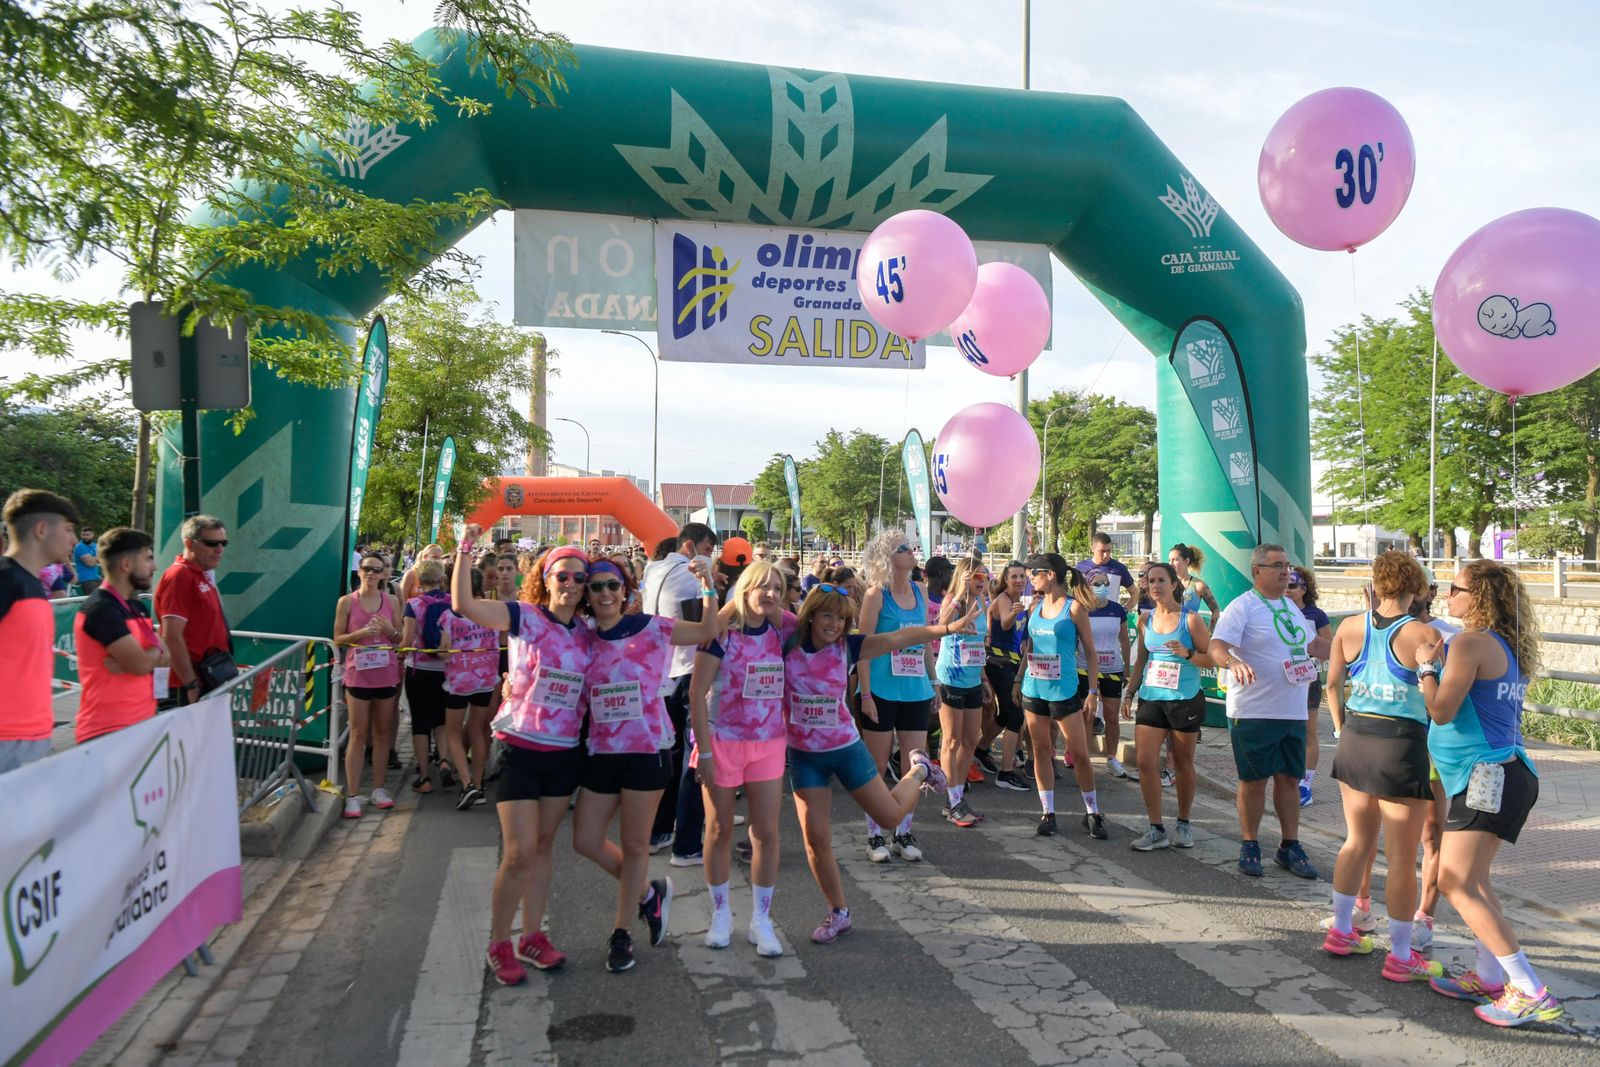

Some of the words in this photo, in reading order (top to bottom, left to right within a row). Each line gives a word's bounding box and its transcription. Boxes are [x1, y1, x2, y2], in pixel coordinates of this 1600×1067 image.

[1335, 142, 1384, 209] 30'
[1161, 252, 1194, 265] CAJA
[1198, 250, 1241, 262] RURAL
[1171, 266, 1185, 274] DE
[1188, 262, 1235, 273] GRANADA
[752, 272, 847, 294] deportes
[876, 256, 906, 304] 45'
[794, 296, 862, 311] Granada
[748, 315, 914, 361] SALIDA
[548, 682, 569, 694] 4746
[1351, 680, 1408, 702] PACER
[604, 695, 626, 708] 5012
[17, 869, 61, 938] CSIF
